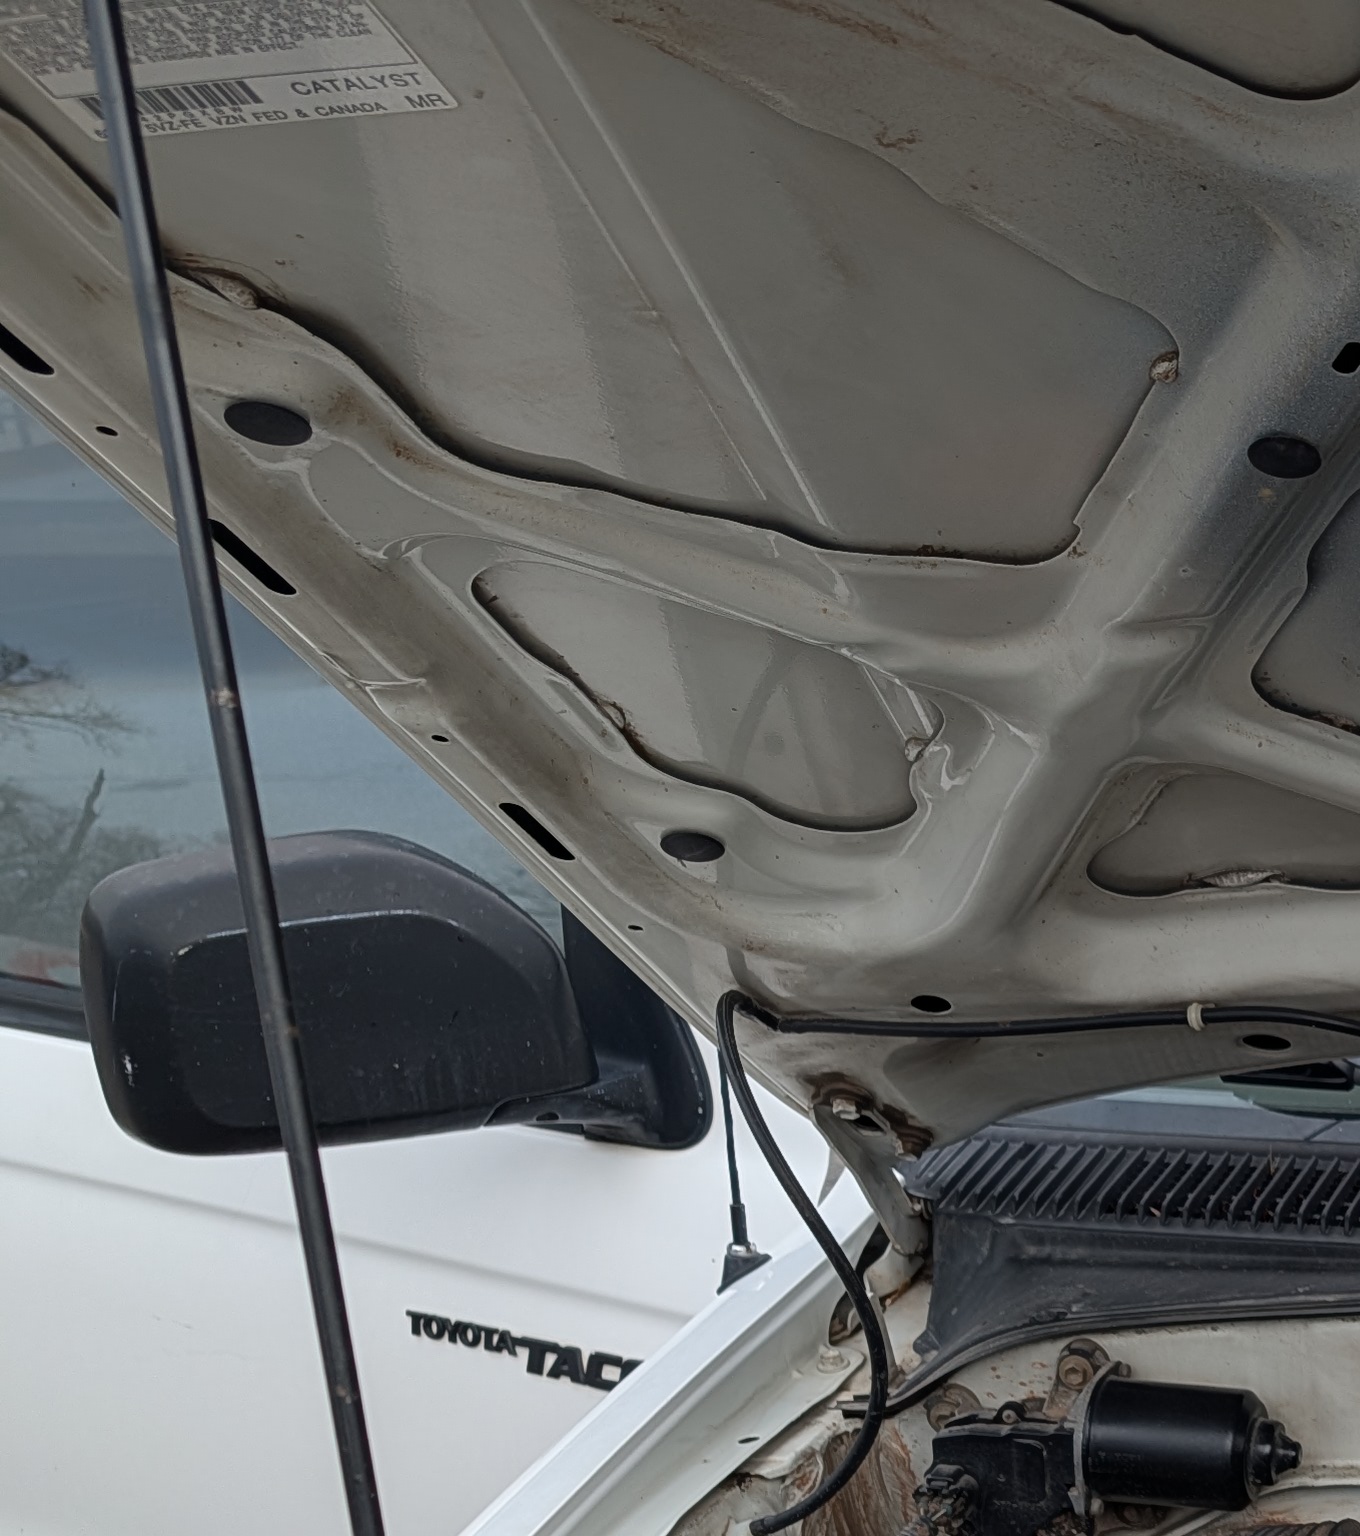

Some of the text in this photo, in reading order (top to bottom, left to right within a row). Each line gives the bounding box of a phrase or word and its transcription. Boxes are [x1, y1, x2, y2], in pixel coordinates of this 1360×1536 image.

[290, 72, 421, 96] CATALYST
[408, 94, 449, 110] MR
[145, 101, 388, 133] 5VZ-FE VZN FED & CANADA
[406, 1309, 518, 1357] TOYOTA
